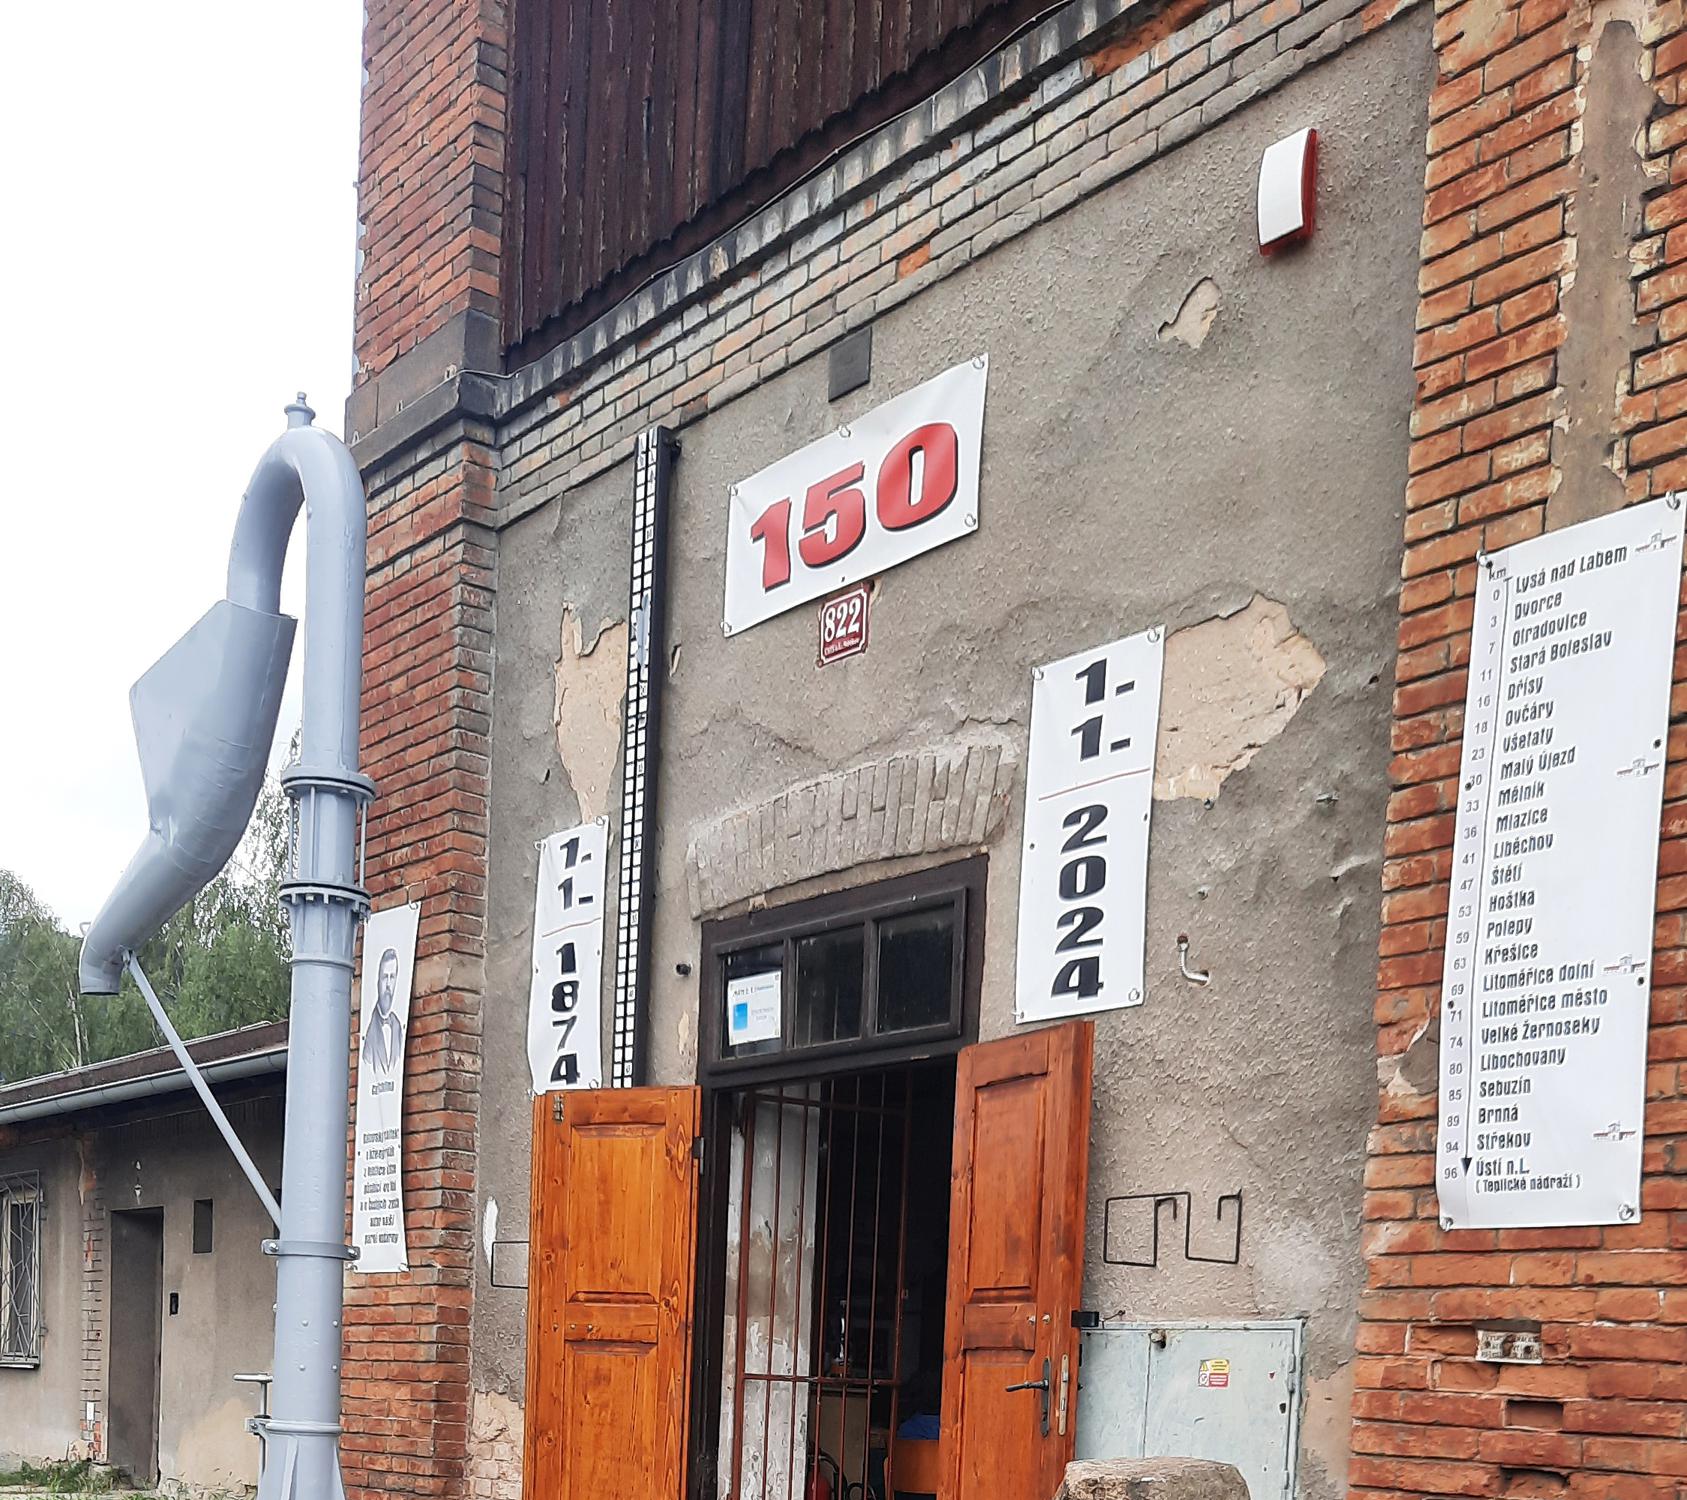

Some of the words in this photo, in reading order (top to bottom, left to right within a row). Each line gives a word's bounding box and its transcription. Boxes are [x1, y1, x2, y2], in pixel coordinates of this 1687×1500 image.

[751, 422, 959, 592] 150
[1488, 566, 1507, 582] km
[1493, 589, 1500, 601] 0
[1515, 568, 1546, 593] Lysá
[1550, 559, 1575, 583] nad
[1579, 546, 1628, 573] Labem
[824, 596, 861, 643] 822
[1490, 615, 1497, 629] 3
[1514, 591, 1562, 621] Dvorce
[1489, 642, 1496, 655] 7
[1512, 611, 1587, 647] Otradovice
[1479, 668, 1492, 682] 11
[1510, 647, 1546, 674] Stará
[1550, 630, 1612, 662] Boleslav
[1507, 676, 1544, 701] Dřísy
[1474, 720, 1488, 735] 18
[1505, 700, 1554, 727] Ovčáry
[1471, 747, 1485, 761] 23
[1502, 726, 1554, 753] Všetaty
[1469, 773, 1482, 786] 30
[1500, 753, 1534, 780] Malý
[1538, 745, 1576, 771] Újezd
[1465, 799, 1480, 813] 33
[1497, 780, 1545, 807] Mělník
[1463, 826, 1477, 839] 36
[1496, 807, 1548, 833] Mlazice
[1462, 852, 1475, 865] 41
[1493, 833, 1554, 860] Liběchov
[1460, 878, 1474, 891] 47
[1491, 862, 1523, 886] Štětí
[1458, 905, 1472, 918] 53
[1488, 889, 1535, 912] Hoštka
[1456, 931, 1470, 944] 59
[1486, 917, 1533, 939] Polepy
[1453, 957, 1467, 970] 63
[1484, 943, 1538, 966] Křešice
[1450, 983, 1465, 997] 69
[1482, 967, 1554, 993] Litoměřice
[1558, 959, 1596, 982] dolní
[1450, 1009, 1462, 1022] 71
[1482, 993, 1556, 1019] Litoměřice
[1560, 987, 1608, 1009] město
[1449, 1036, 1463, 1049] 74
[1481, 1023, 1518, 1045] Velké
[1521, 1015, 1601, 1042] Žernoseky
[1449, 1062, 1463, 1076] 80
[1480, 1047, 1566, 1072] Libochovany
[1479, 1075, 1531, 1098] Sebuzín
[1446, 1115, 1460, 1127] 89
[1478, 1103, 1519, 1124] Brnná
[1445, 1141, 1459, 1154] 94
[1476, 1131, 1531, 1150] Střekov
[1444, 1167, 1458, 1179] 96
[1475, 1156, 1502, 1176] Ústí
